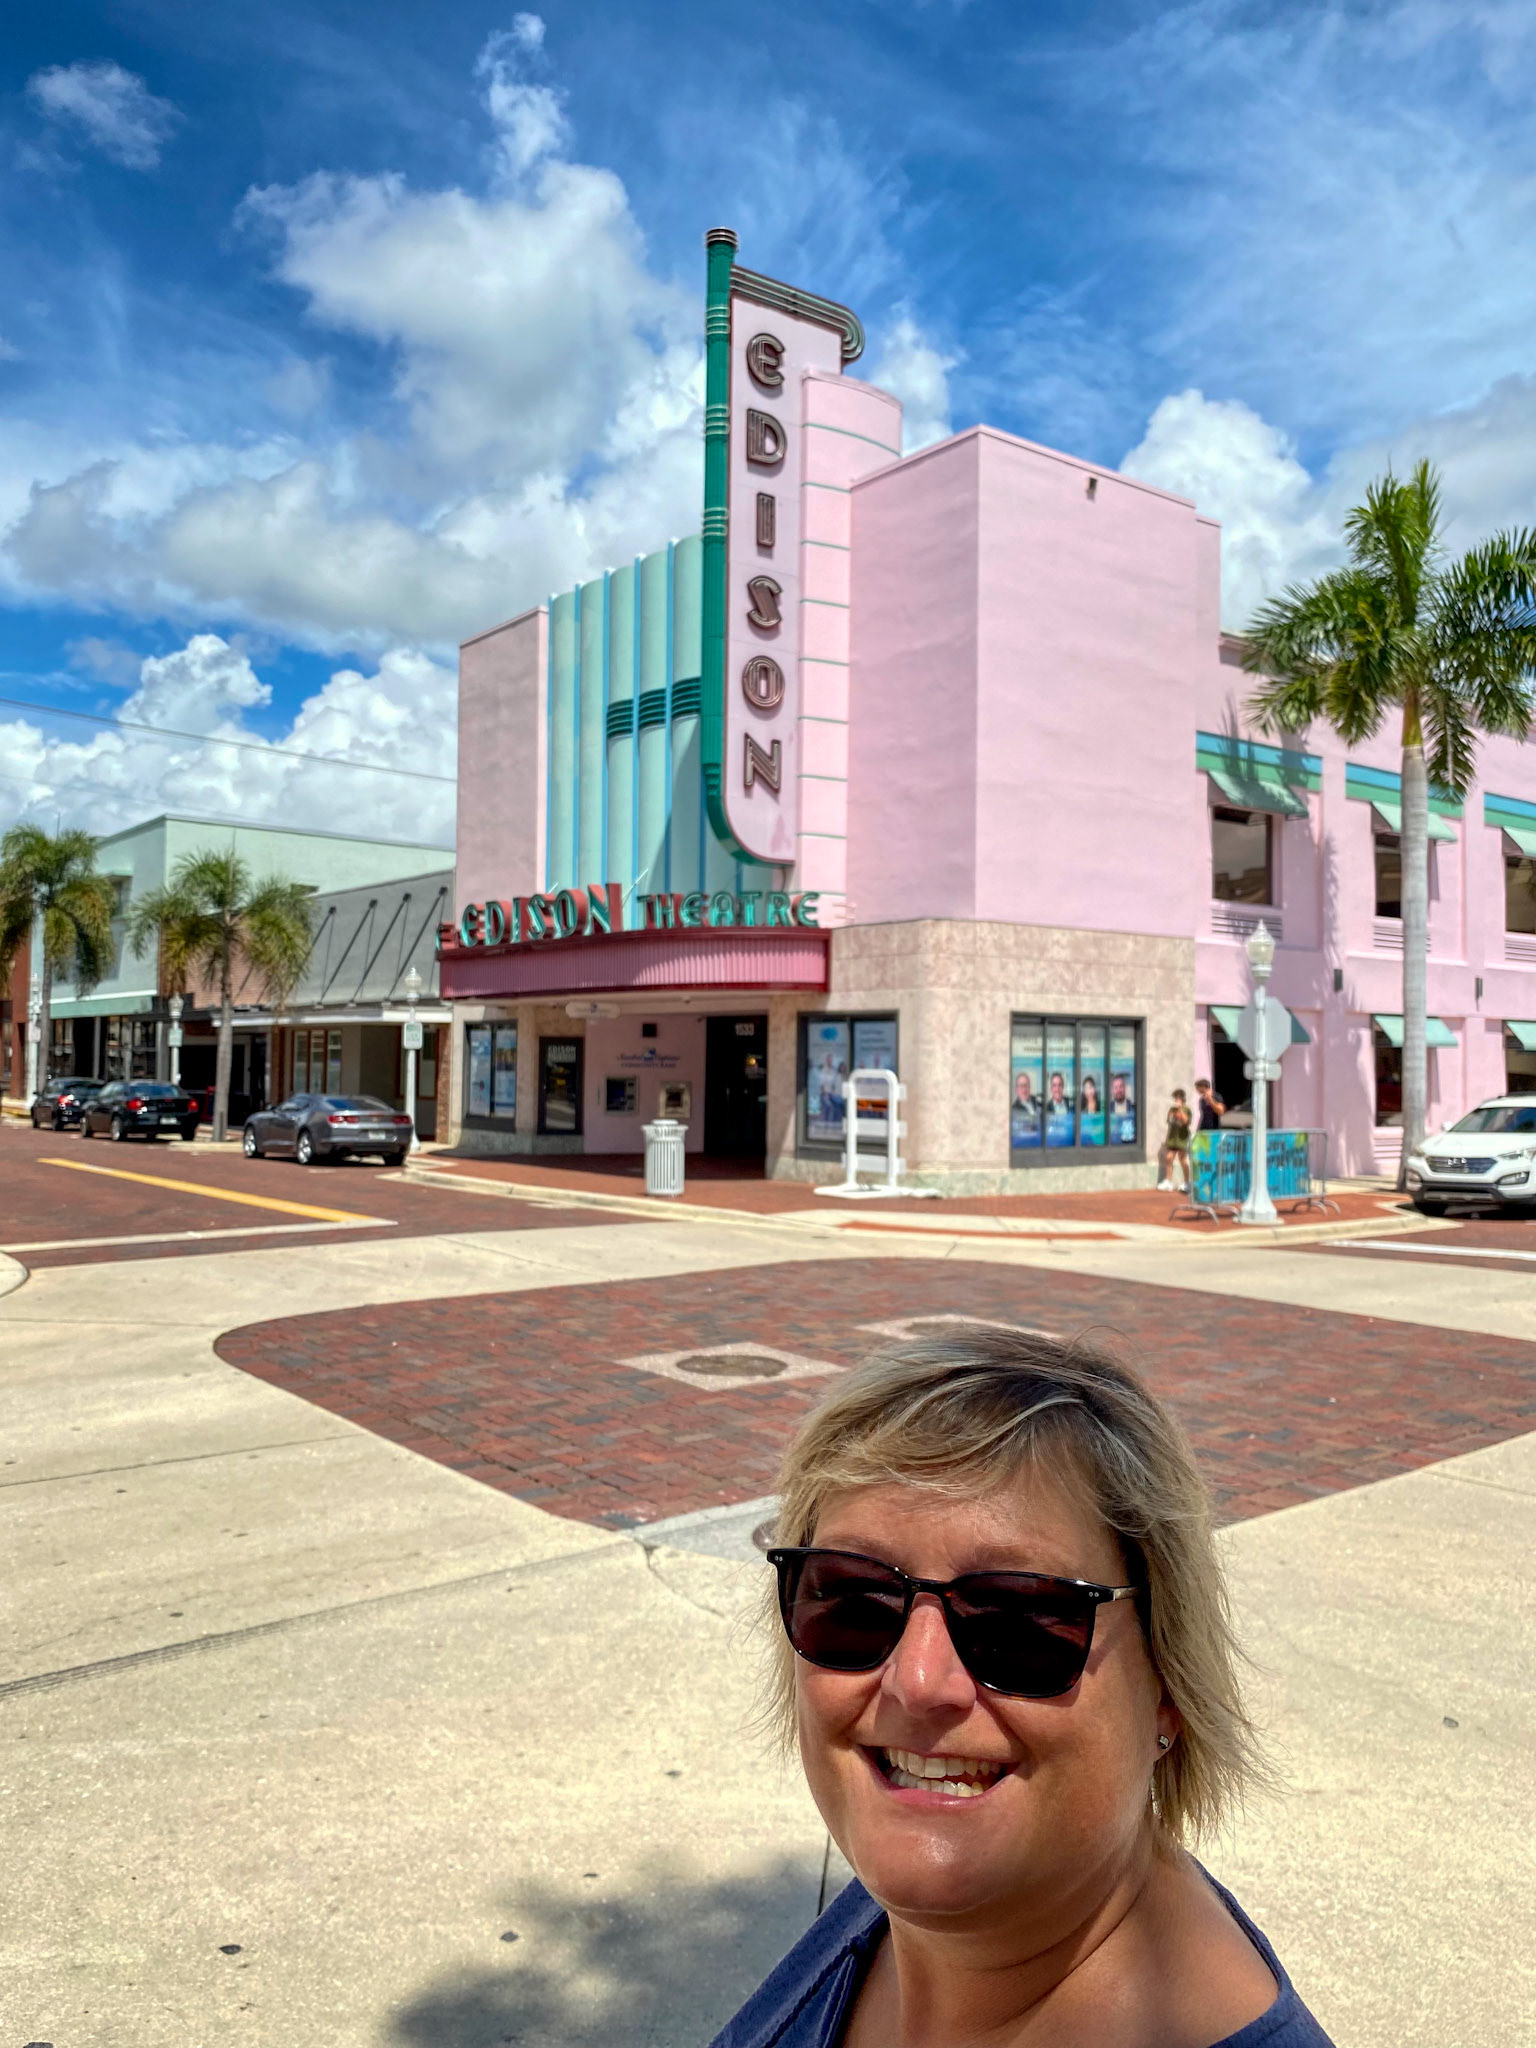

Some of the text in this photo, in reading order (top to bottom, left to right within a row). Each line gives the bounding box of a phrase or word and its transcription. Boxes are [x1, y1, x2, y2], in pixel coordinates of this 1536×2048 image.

[742, 333, 786, 792] EDISON
[460, 882, 622, 948] EDISON
[636, 890, 820, 931] THEATRE
